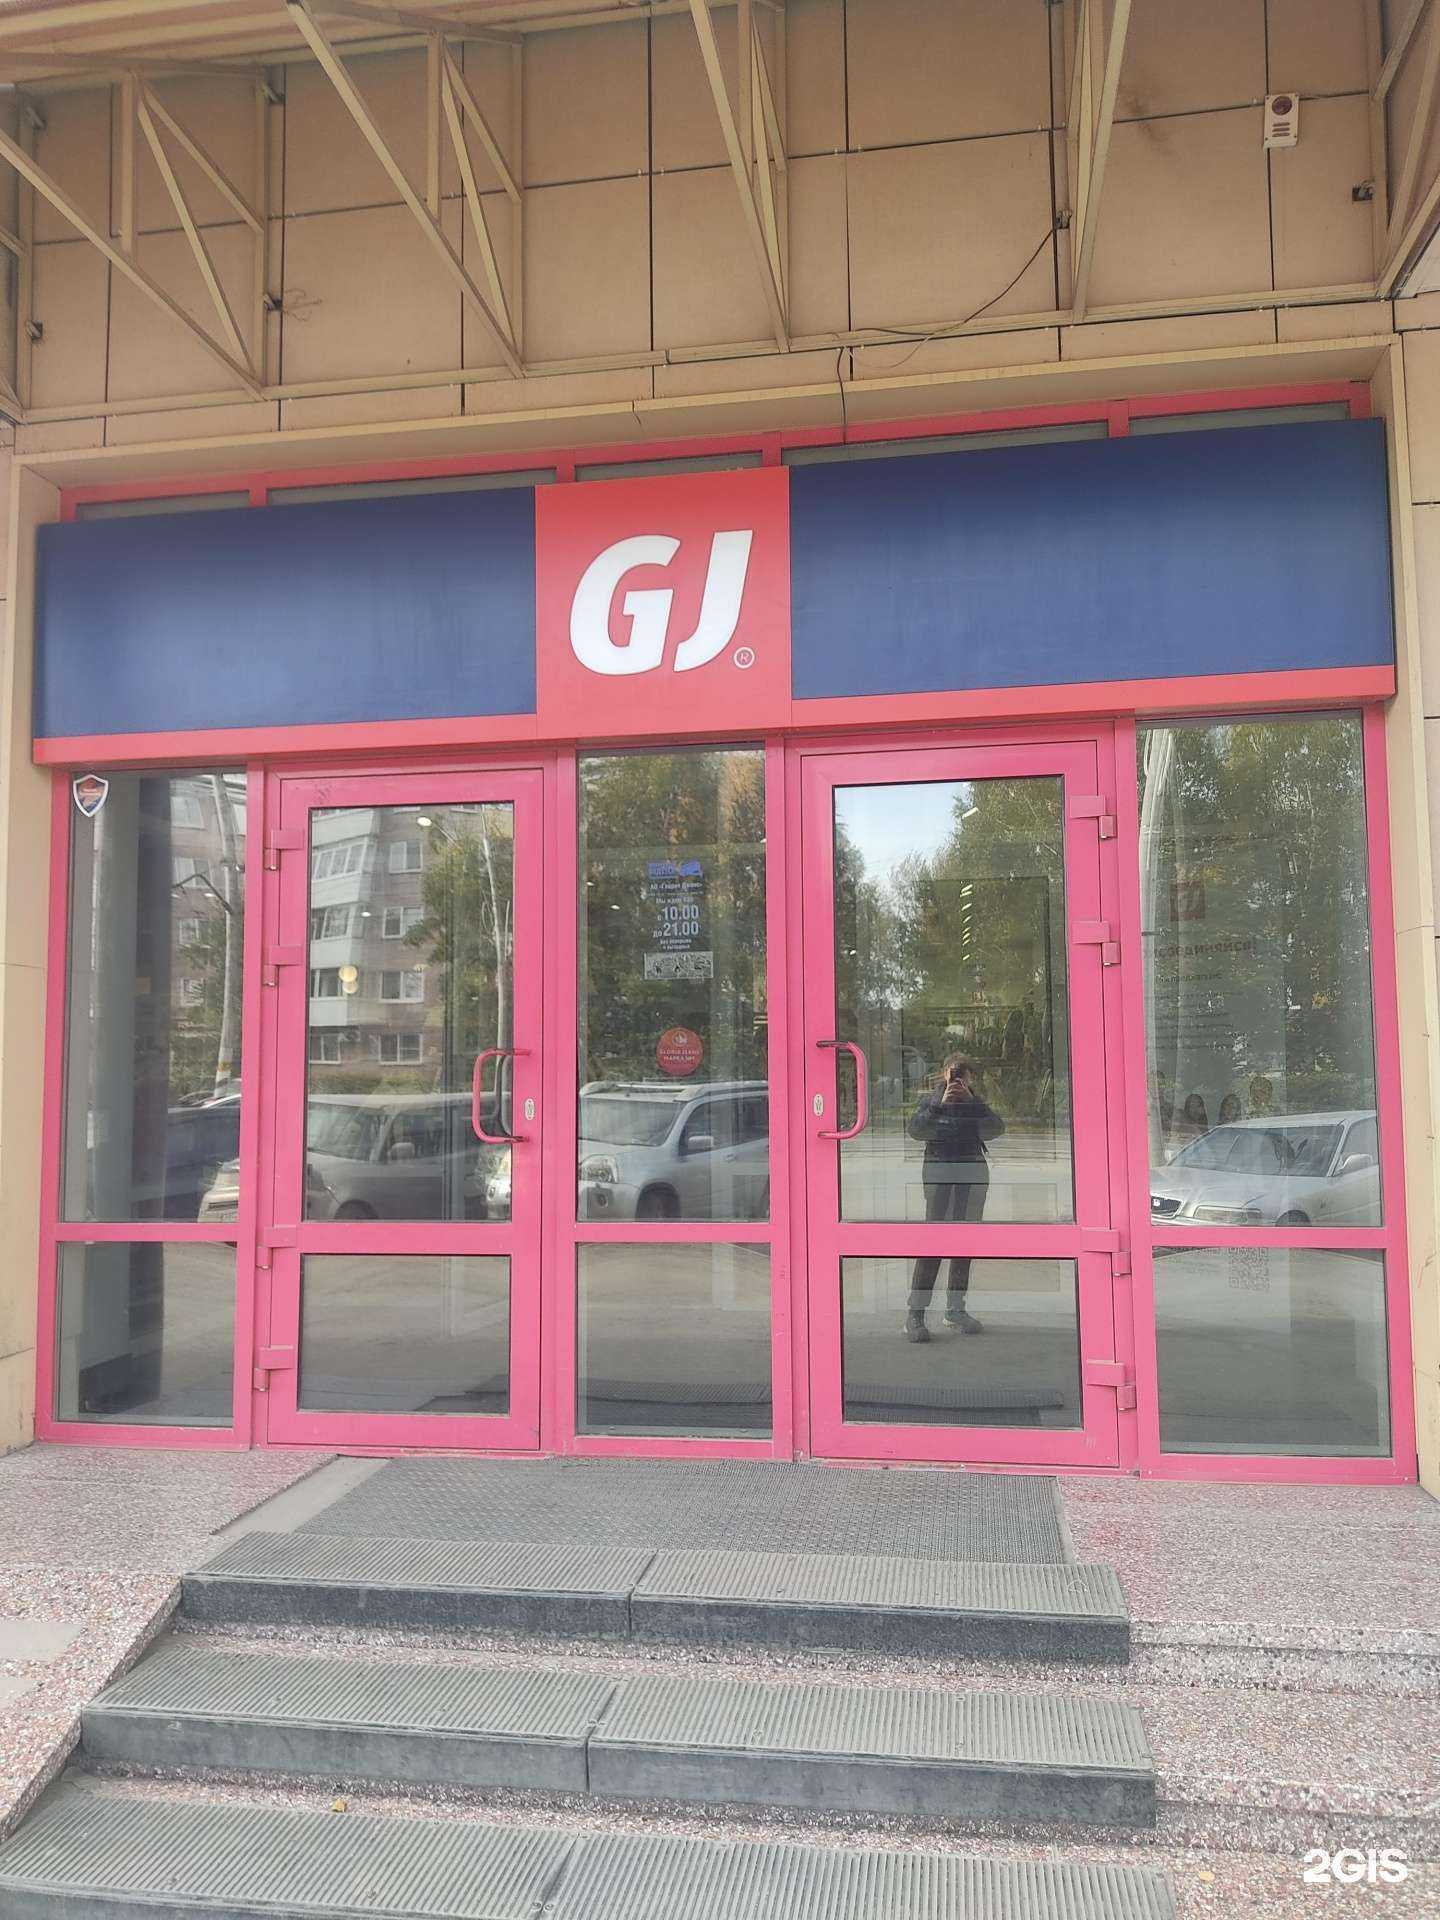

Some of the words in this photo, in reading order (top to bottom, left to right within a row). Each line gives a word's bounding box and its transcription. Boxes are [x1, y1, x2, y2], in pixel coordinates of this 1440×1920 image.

[569, 529, 754, 676] GJ
[662, 904, 699, 920] 10.00
[663, 921, 699, 937] 21.00
